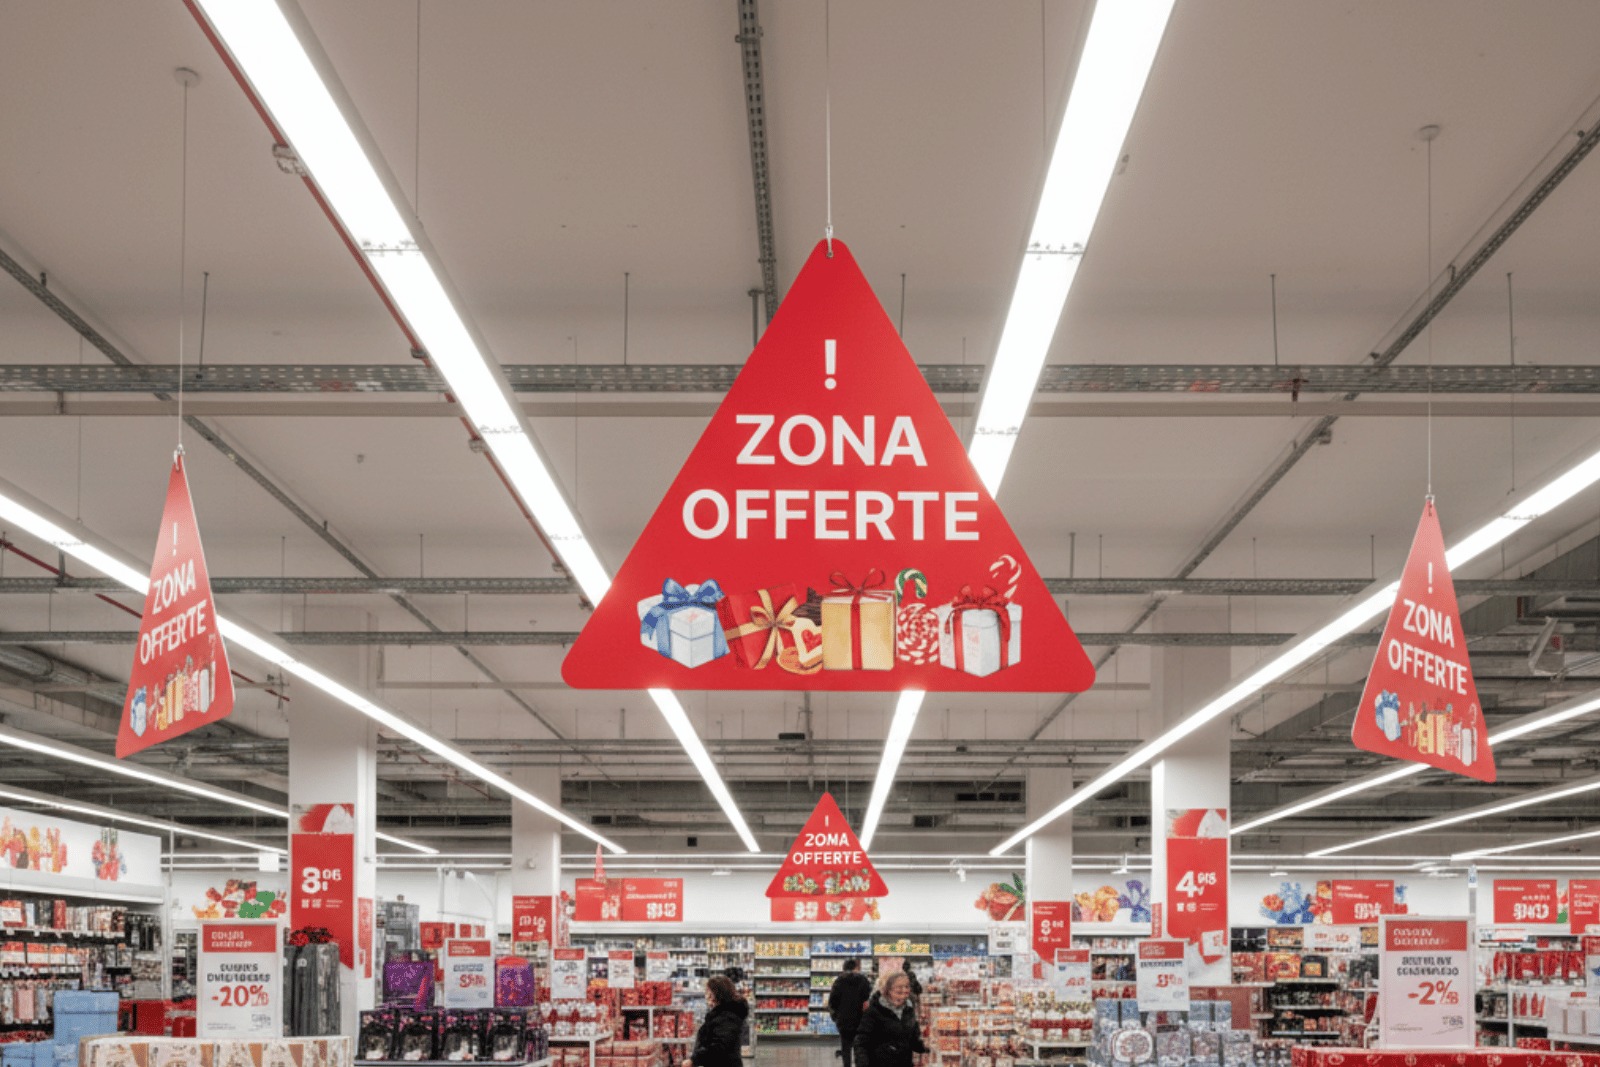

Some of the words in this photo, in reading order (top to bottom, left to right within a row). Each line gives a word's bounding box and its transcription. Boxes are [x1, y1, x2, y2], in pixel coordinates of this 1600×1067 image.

[824, 338, 837, 390] !
[735, 414, 928, 467] ZONA
[682, 488, 980, 541] OFFERTE
[152, 559, 196, 615] ZONA
[1427, 562, 1434, 594] !
[140, 599, 207, 666] OFFERTE
[1403, 599, 1455, 648] ZONA
[1387, 638, 1468, 695] OFFERTE
[792, 851, 863, 865] OFFERTE
